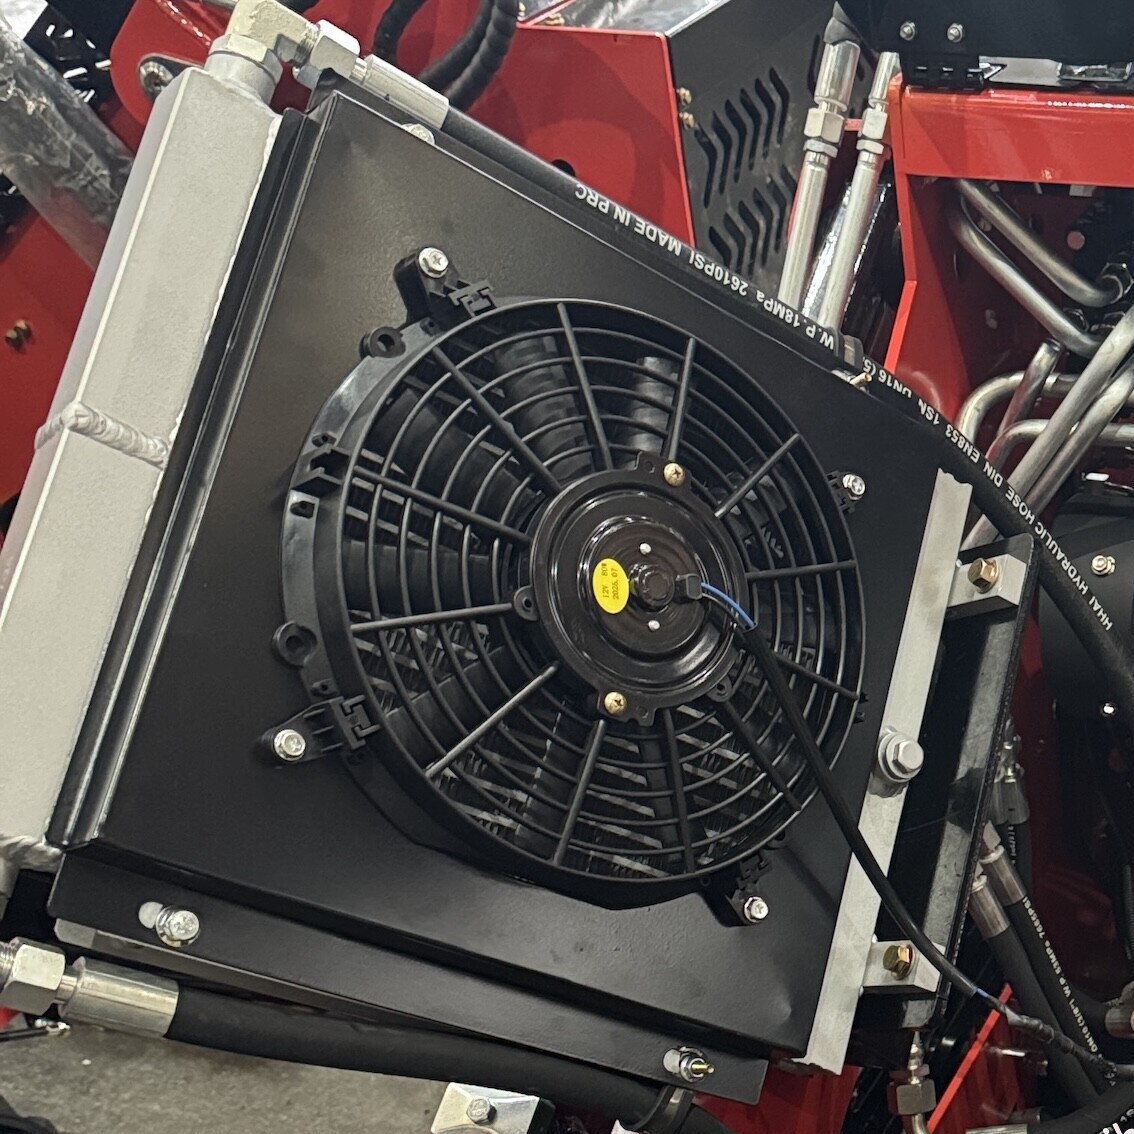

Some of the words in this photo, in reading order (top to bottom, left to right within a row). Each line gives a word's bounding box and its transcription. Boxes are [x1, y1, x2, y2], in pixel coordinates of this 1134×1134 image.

[574, 184, 611, 214] PRC
[613, 205, 630, 226] IN
[634, 218, 682, 257] MADE
[688, 250, 749, 296] 2610PSI
[945, 424, 980, 463] EN853
[983, 462, 1003, 488] DIN
[1005, 487, 1035, 525] HOSE
[1035, 522, 1088, 595] HYDRAULIC
[1089, 596, 1113, 630] HHAI
